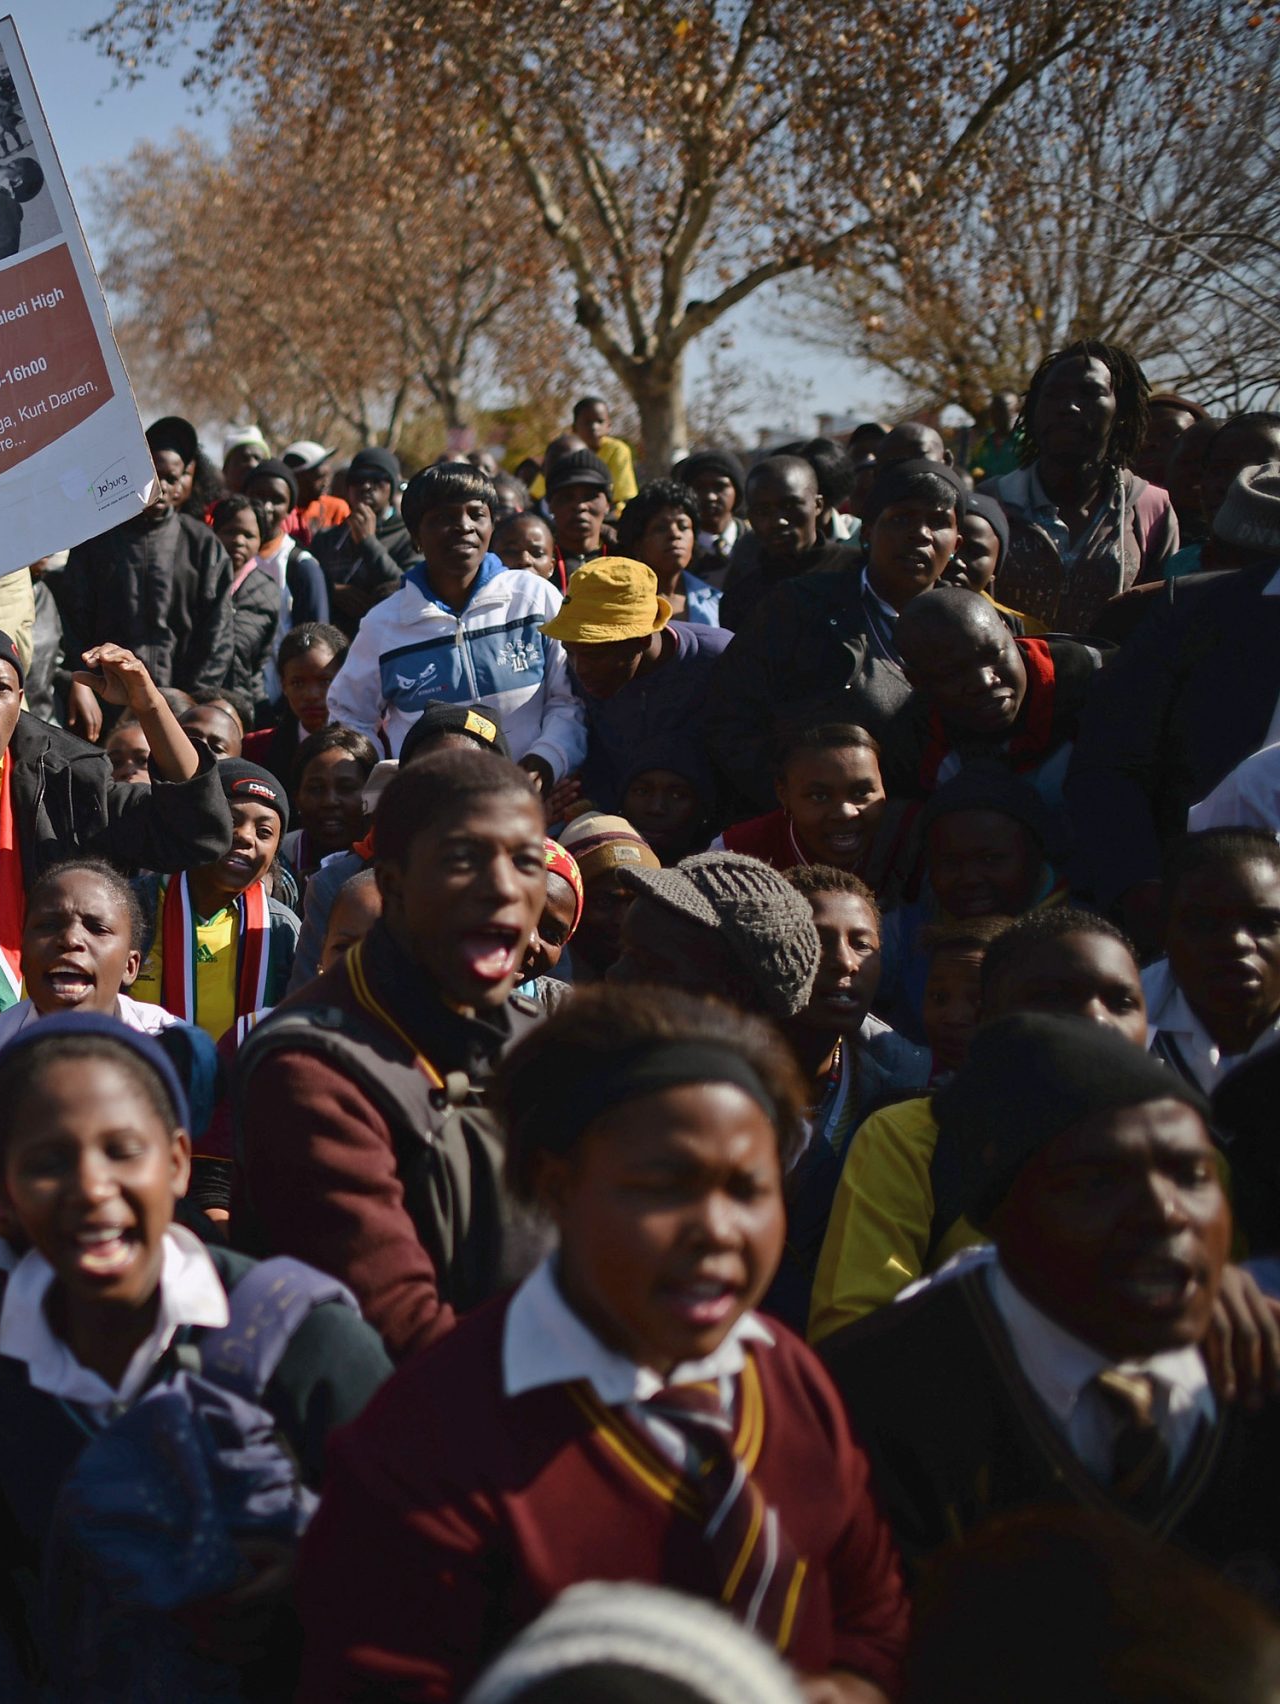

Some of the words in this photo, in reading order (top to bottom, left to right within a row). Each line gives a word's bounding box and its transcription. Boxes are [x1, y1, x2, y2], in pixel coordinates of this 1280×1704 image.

[31, 288, 64, 312] High
[18, 401, 48, 422] Kurt
[48, 381, 98, 410] Darren,
[97, 474, 128, 497] Joburg
